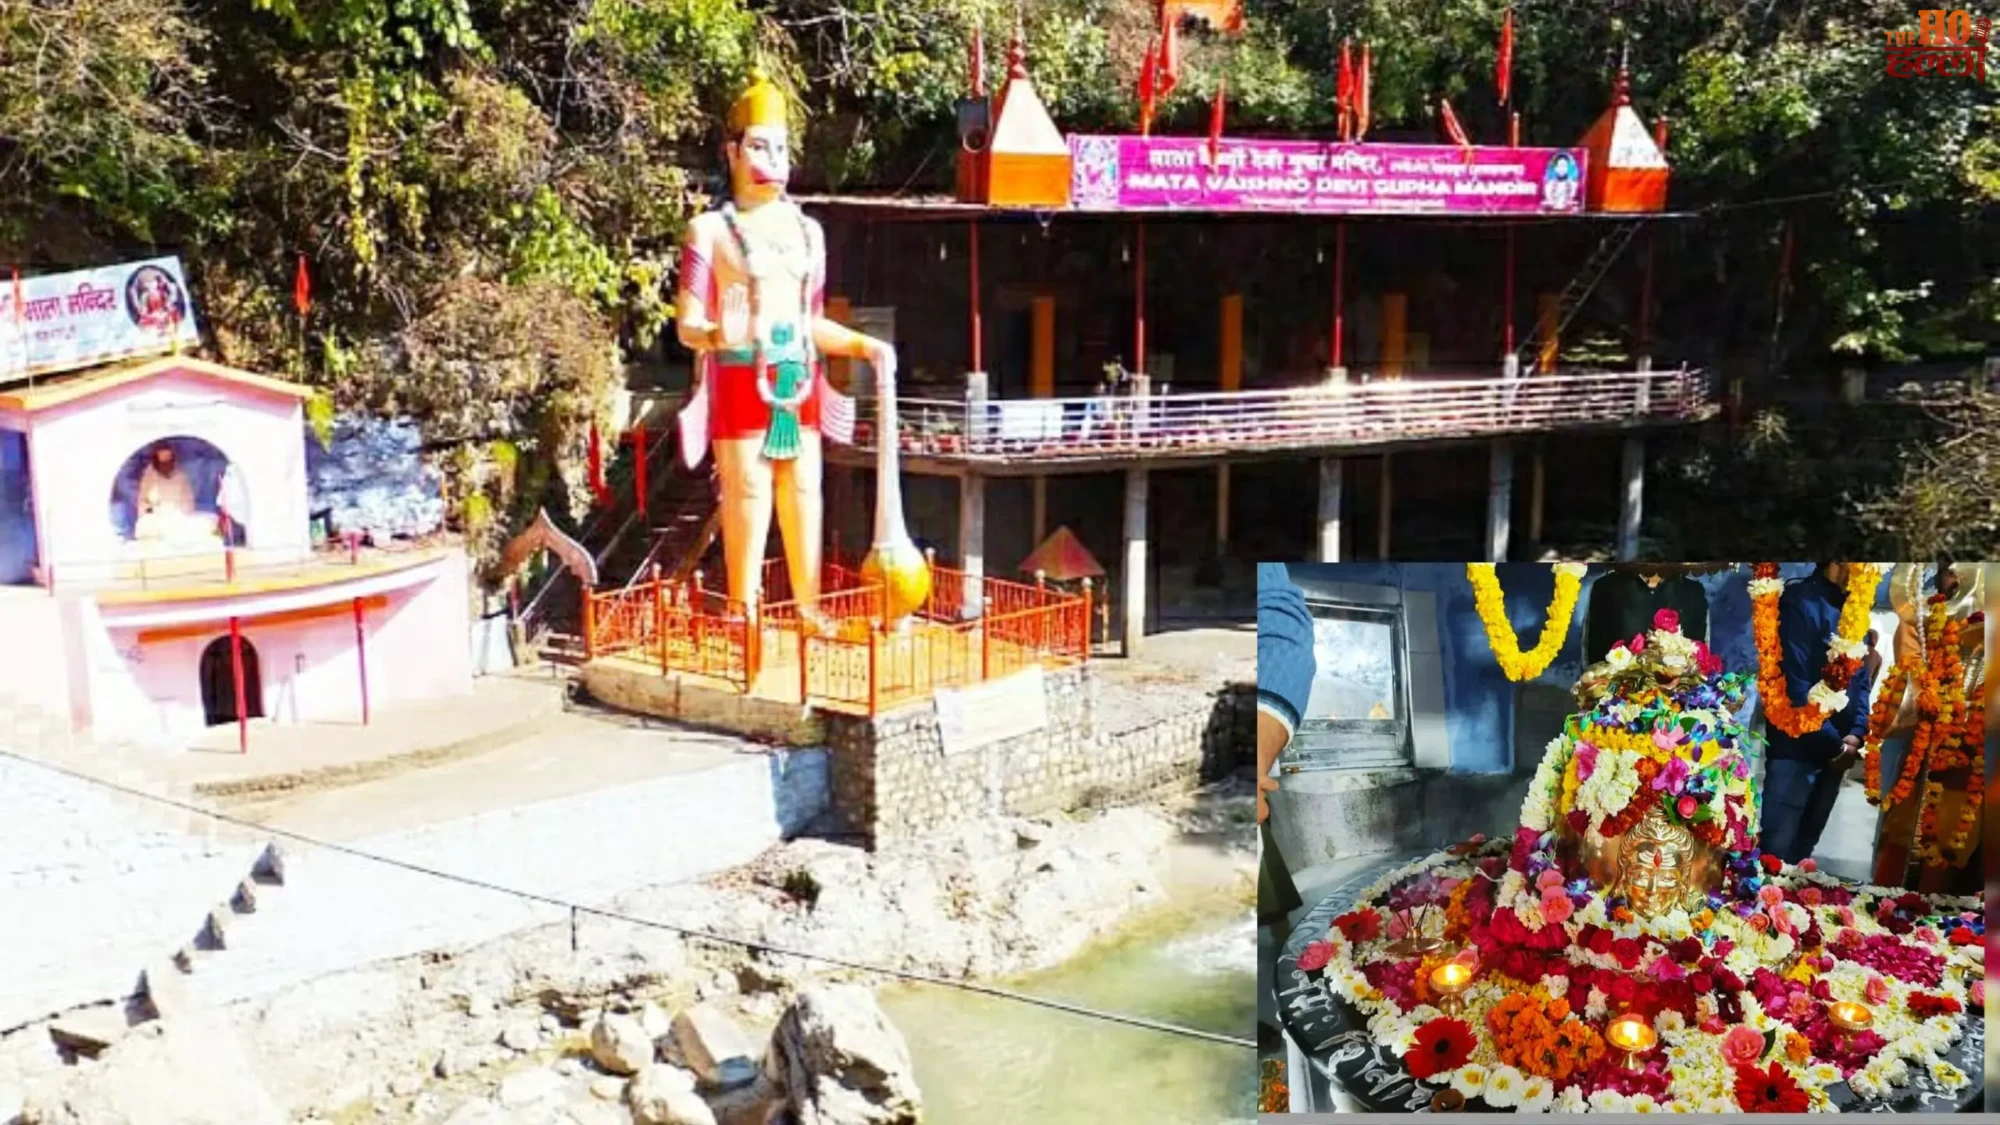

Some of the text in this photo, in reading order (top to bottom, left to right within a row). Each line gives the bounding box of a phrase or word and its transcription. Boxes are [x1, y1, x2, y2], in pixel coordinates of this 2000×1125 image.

[1128, 173, 1538, 196] MATA VAISHNO DEVI GUPHA MANDIR
